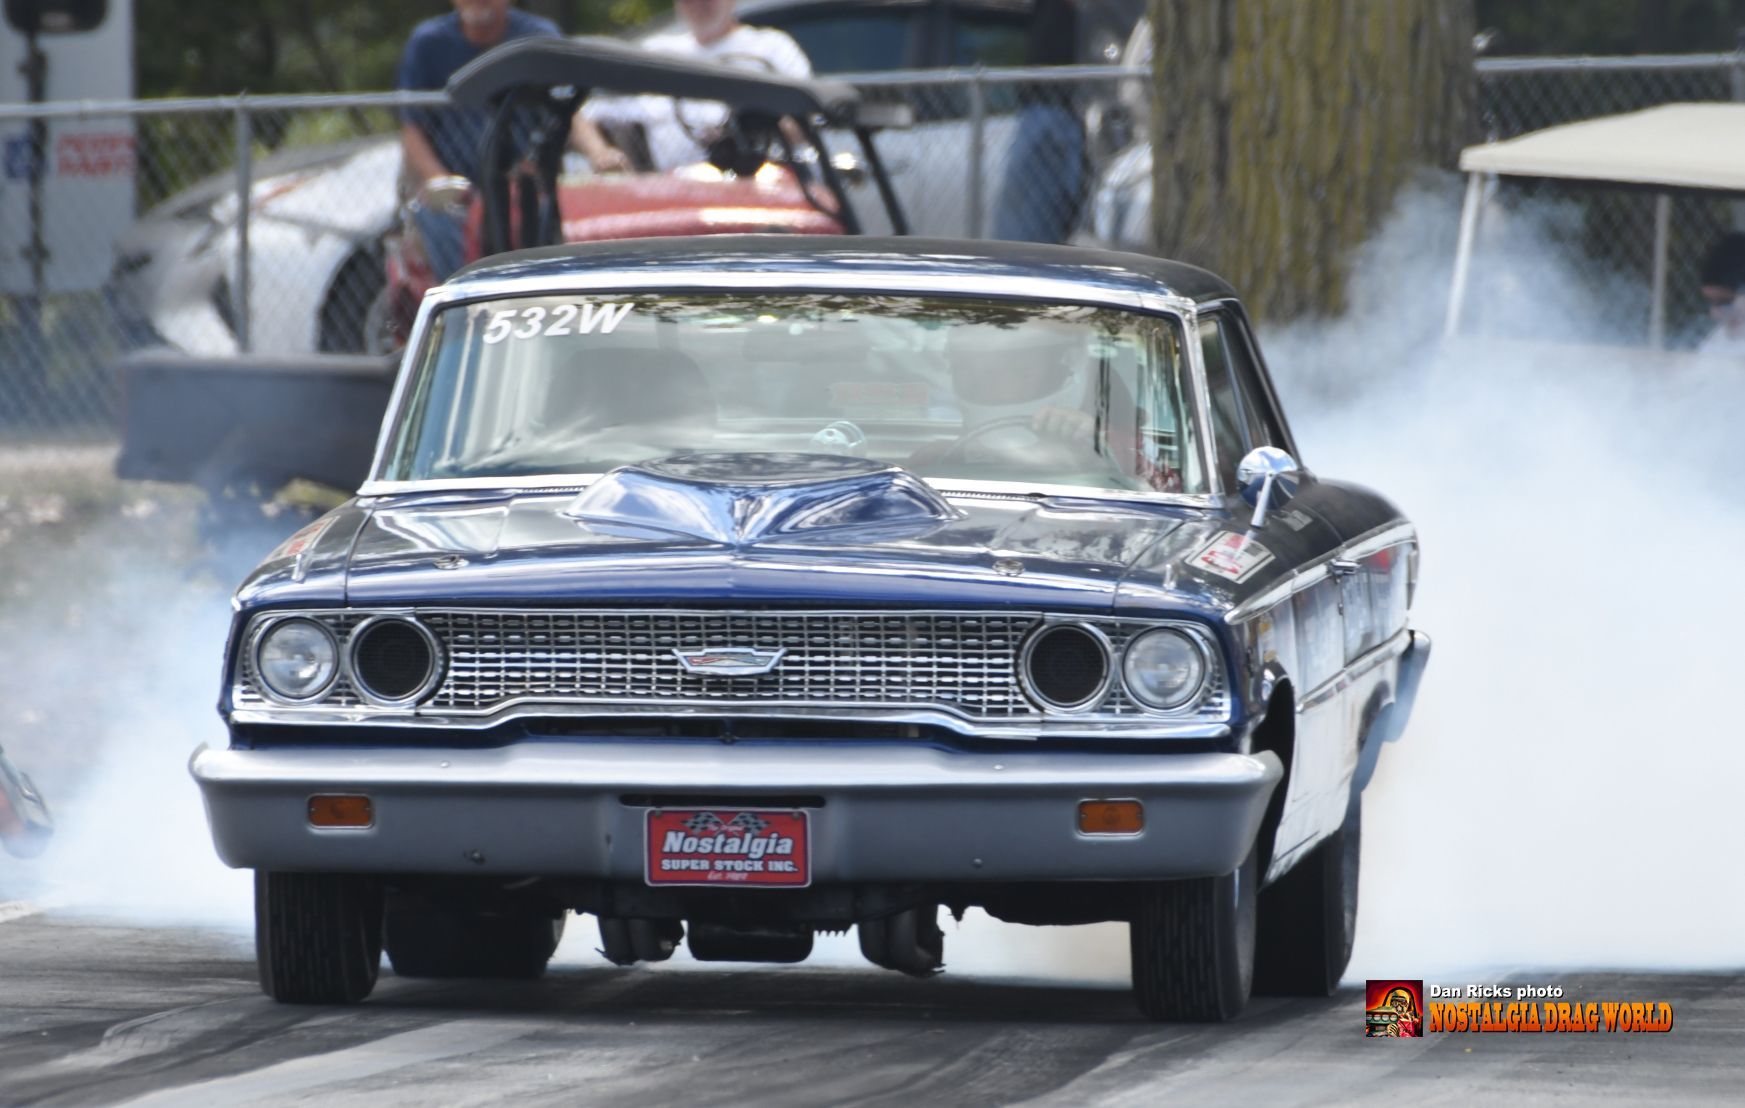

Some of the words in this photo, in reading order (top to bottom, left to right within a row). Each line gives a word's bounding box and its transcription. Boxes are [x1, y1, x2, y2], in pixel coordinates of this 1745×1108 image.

[483, 302, 635, 344] 532W
[662, 831, 793, 858] Nostalgia
[661, 859, 710, 870] SUPER
[714, 860, 764, 871] STOCK
[768, 861, 799, 872] INC.
